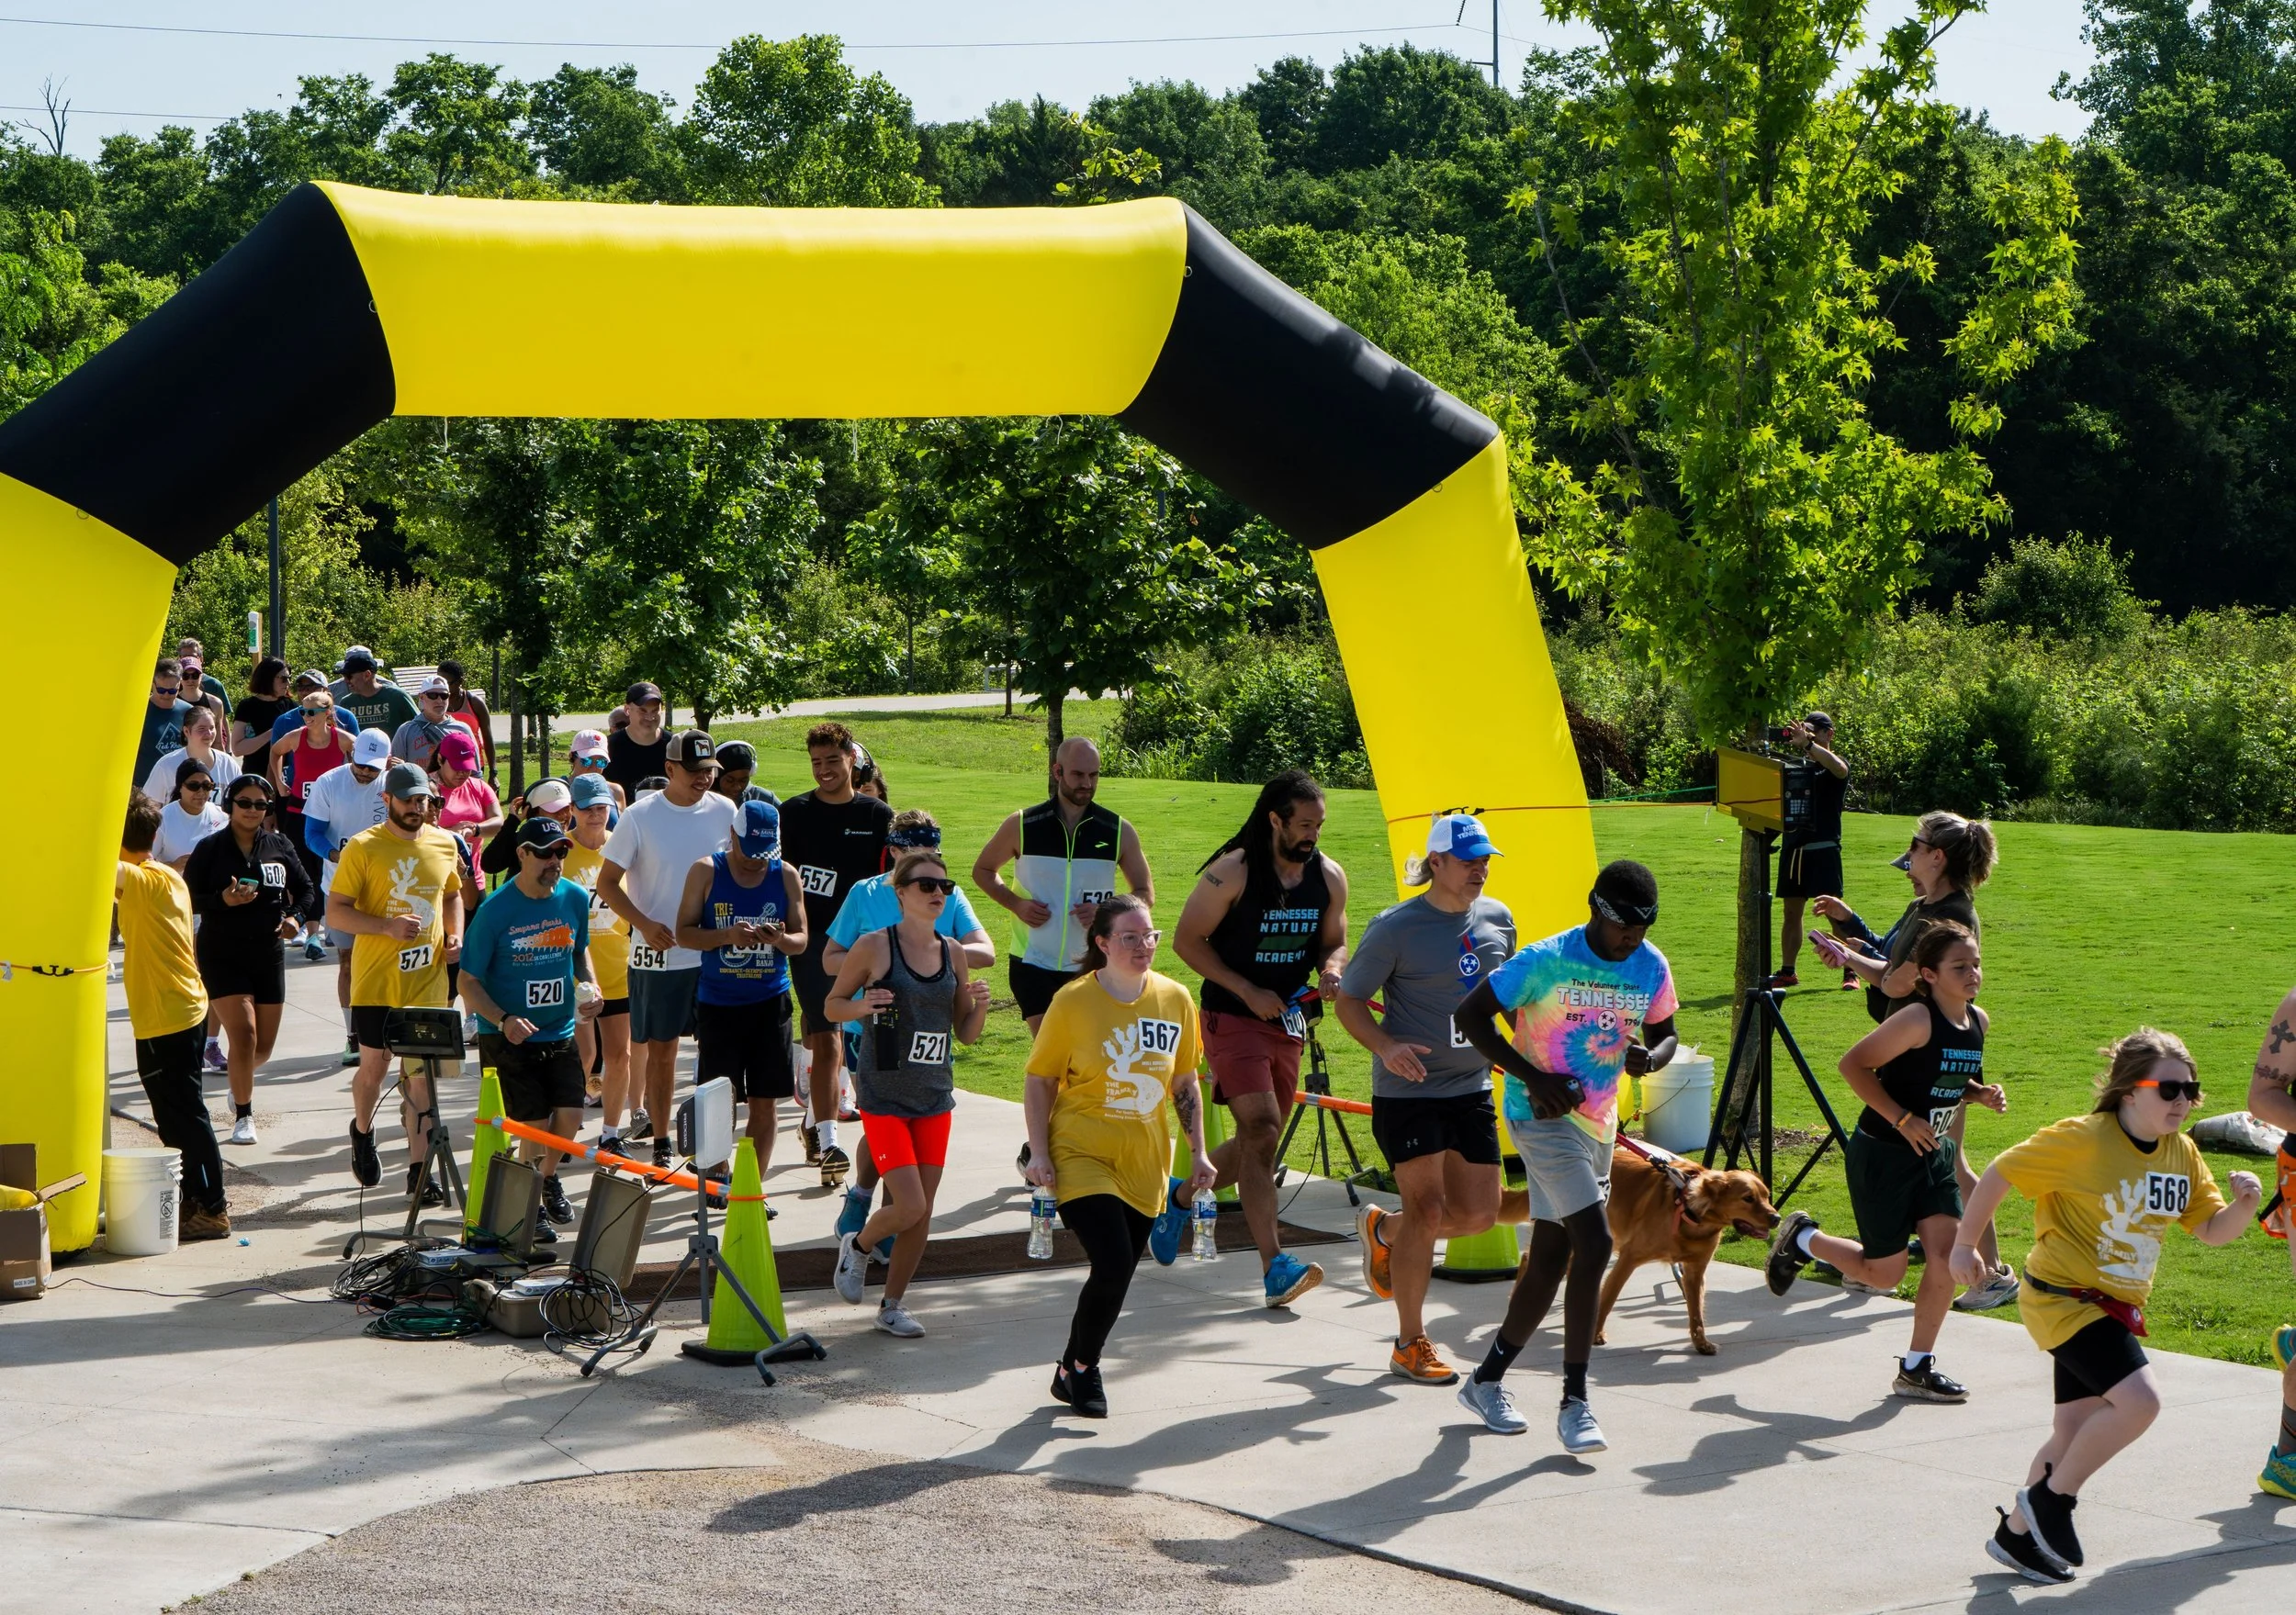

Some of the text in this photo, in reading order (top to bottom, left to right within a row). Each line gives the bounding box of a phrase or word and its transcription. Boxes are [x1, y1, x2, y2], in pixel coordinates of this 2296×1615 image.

[542, 823, 562, 834] USA
[801, 867, 835, 892] 557
[1263, 908, 1319, 920] TENNESSEE
[1260, 922, 1317, 933] NATURE
[400, 947, 429, 970] 571
[634, 946, 665, 968] 554
[529, 981, 562, 1004] 520
[1571, 978, 1640, 991] The Volunteer State
[1557, 987, 1650, 1012] TENNESSEE
[1566, 1012, 1587, 1023] EST.
[913, 1035, 944, 1061] 521
[1142, 1020, 1180, 1053] 567
[1941, 1048, 1982, 1061] TENNESSEE
[1933, 1108, 1958, 1135] 602
[2149, 1176, 2188, 1213] 568
